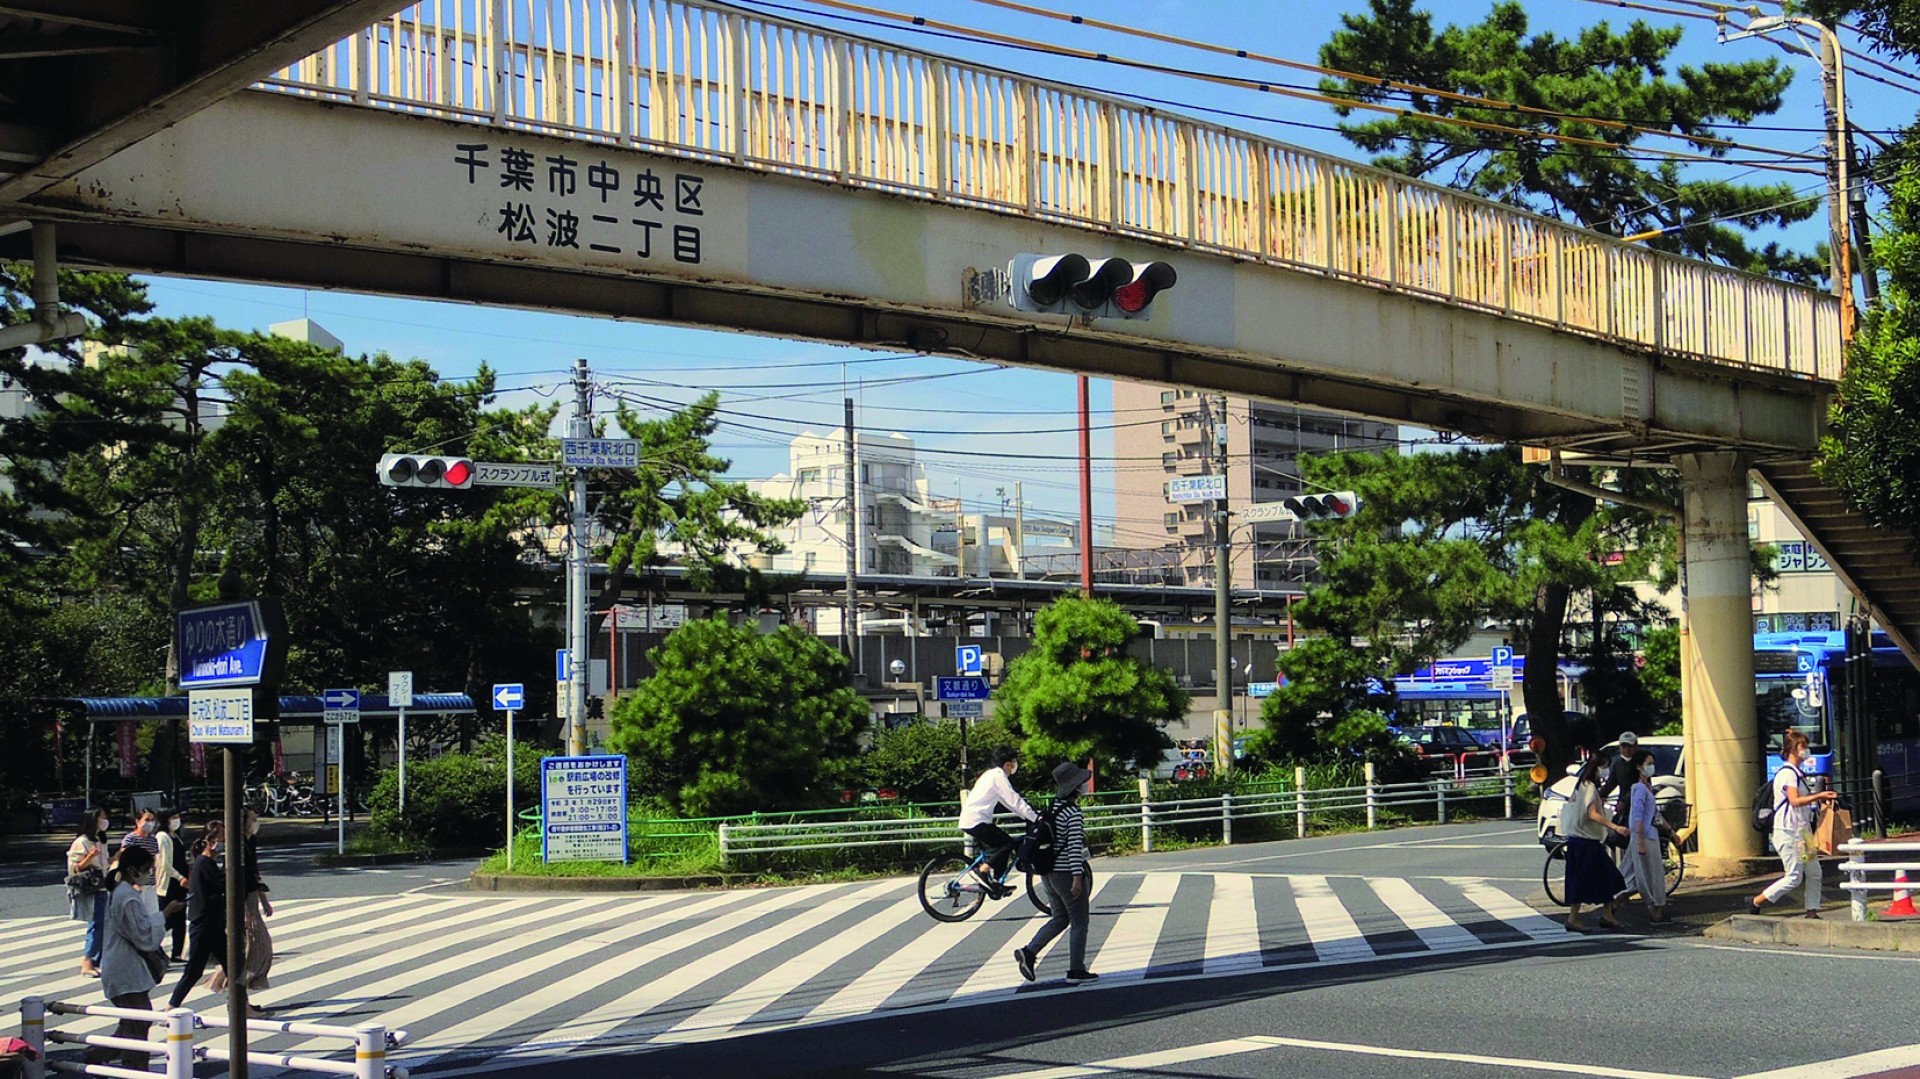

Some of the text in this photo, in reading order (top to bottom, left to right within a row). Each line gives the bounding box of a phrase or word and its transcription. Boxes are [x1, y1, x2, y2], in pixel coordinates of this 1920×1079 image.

[454, 143, 704, 216] 千葉市中央区
[497, 201, 701, 264] 松波二丁目
[565, 441, 635, 456] 西千葉駅北口
[480, 467, 550, 483] スクランブル式
[1172, 478, 1222, 491] 西千葉駅北口
[185, 615, 247, 656] ゆりの木通り
[192, 698, 211, 721] 中央区
[566, 771, 620, 782] 駅前広場の改修
[567, 784, 620, 796] を行っています
